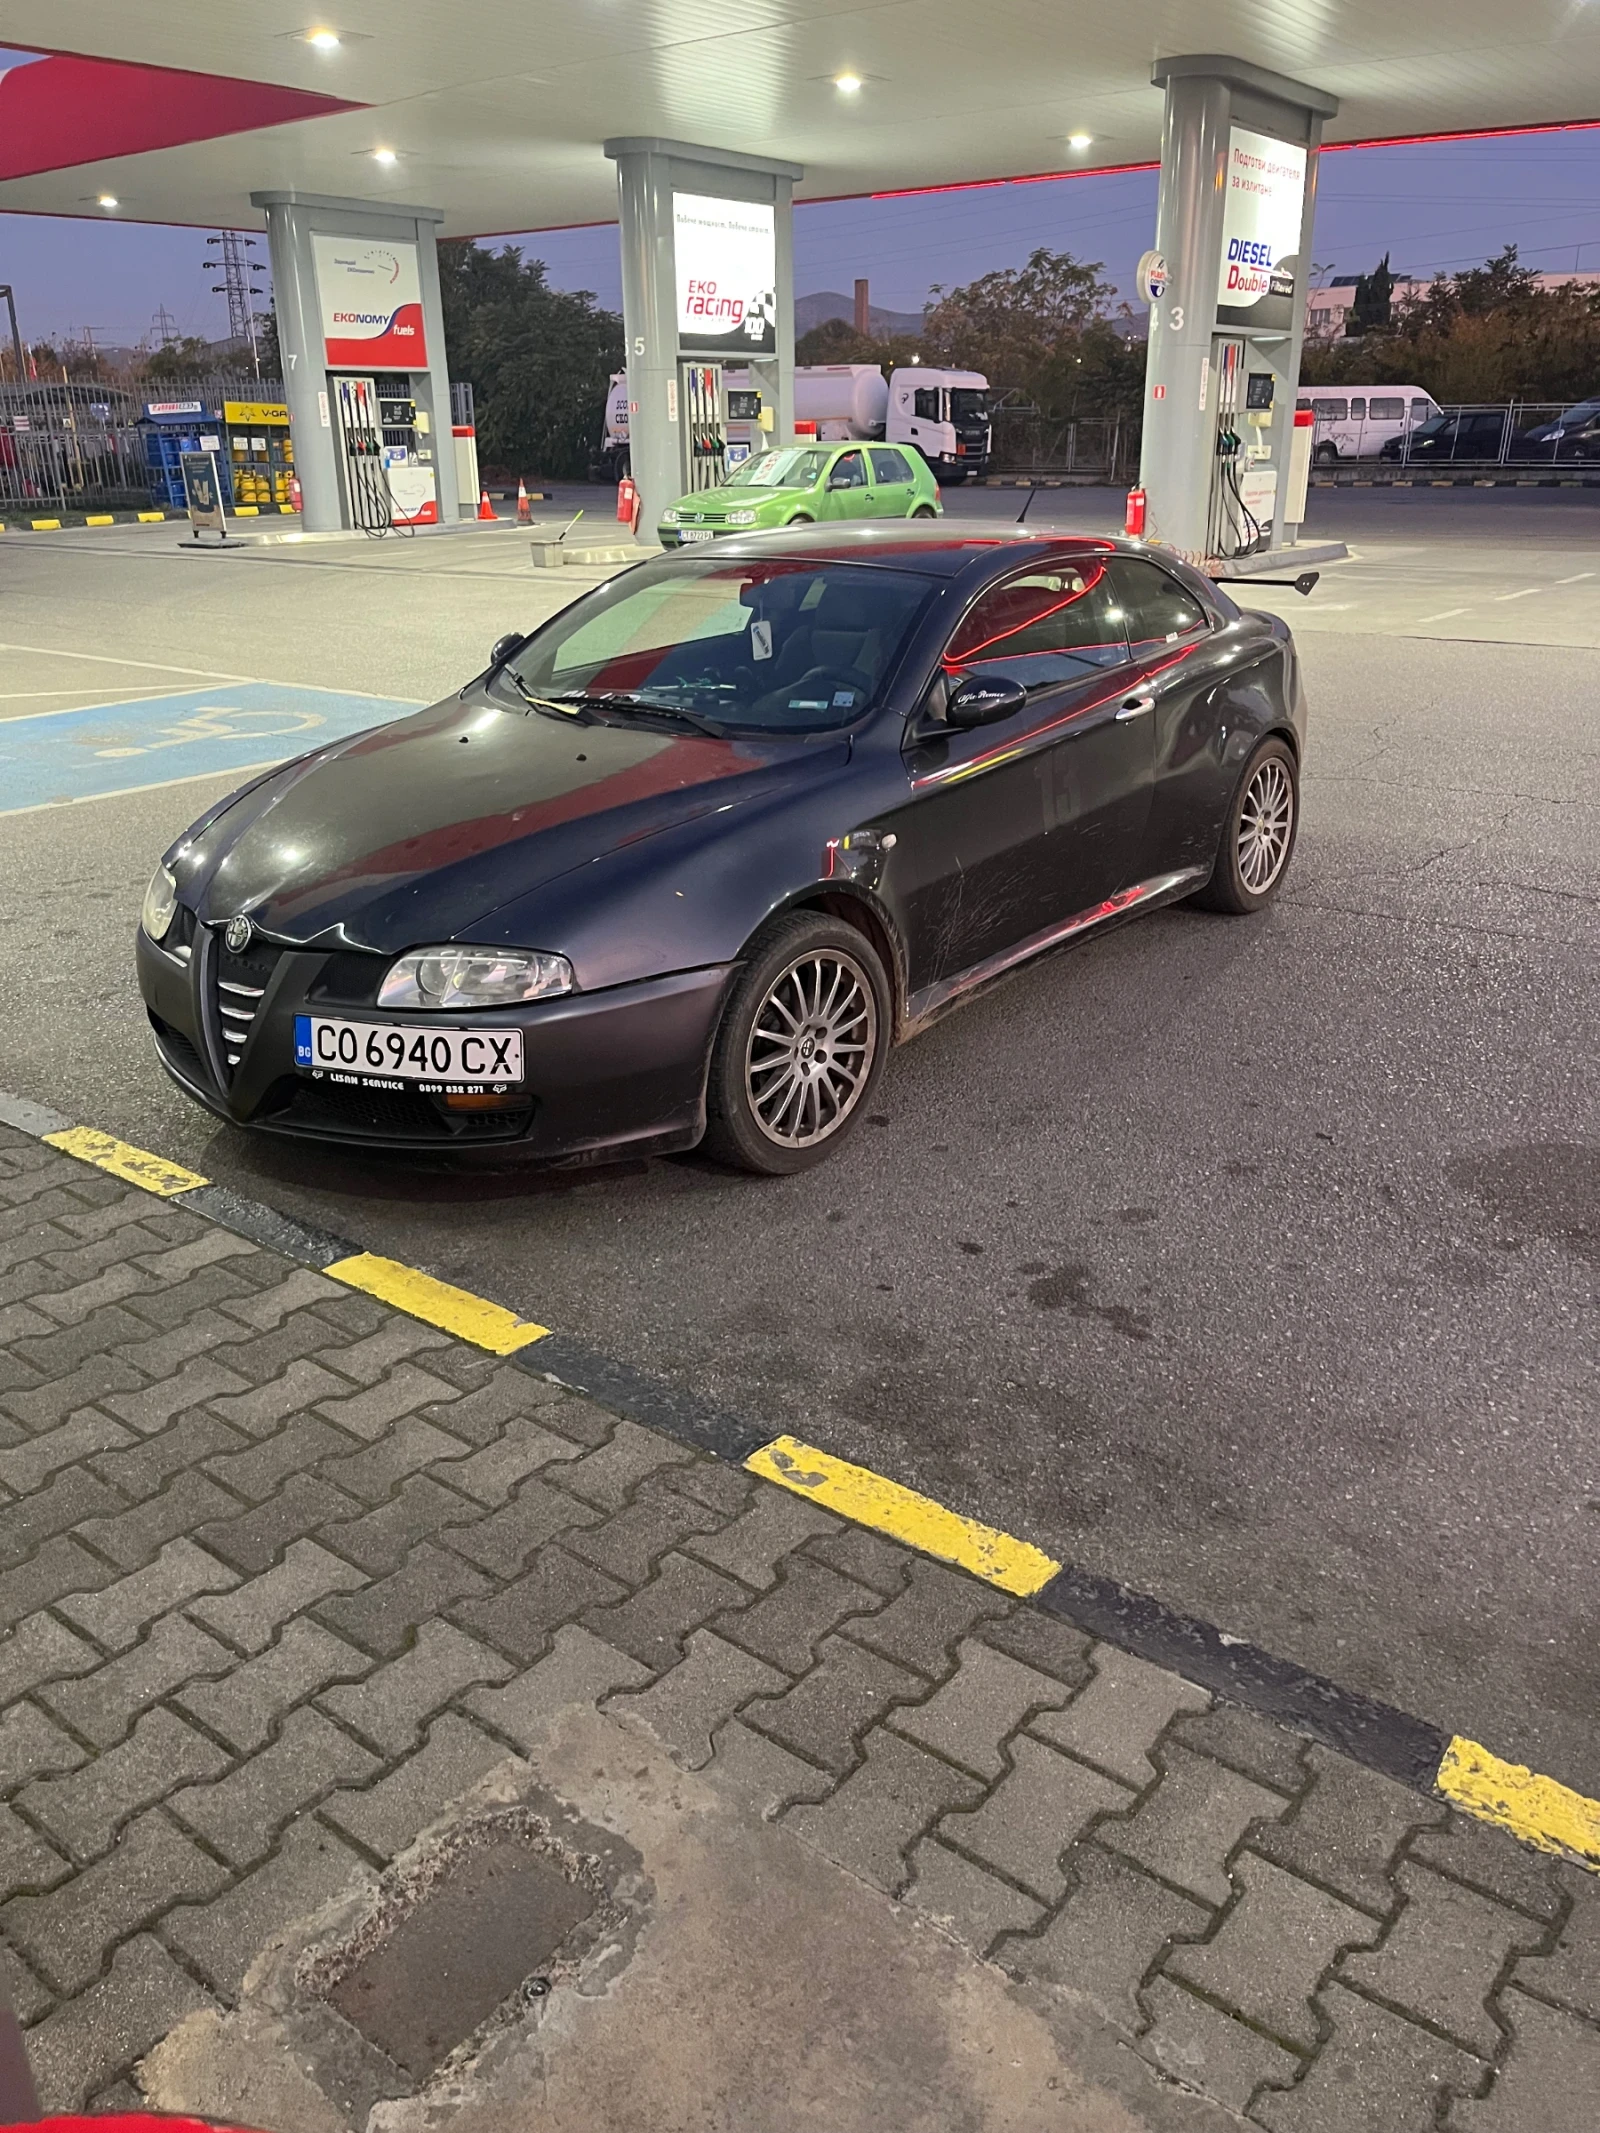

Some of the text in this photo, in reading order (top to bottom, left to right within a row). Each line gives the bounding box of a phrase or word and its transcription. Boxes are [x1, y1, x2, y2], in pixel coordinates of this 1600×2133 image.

[1227, 237, 1272, 267] DIESEL
[688, 279, 717, 295] EKO
[1226, 265, 1268, 293] Double
[333, 312, 390, 325] EKONOMY
[686, 296, 744, 324] racing
[1169, 306, 1185, 331] 3
[393, 324, 415, 336] fuels
[634, 336, 646, 356] 5
[288, 354, 298, 371] 7
[298, 1045, 311, 1058] BG
[317, 1024, 513, 1075] CO 6940 CX
[362, 1078, 405, 1091] SERVICE
[418, 1083, 443, 1093] 0899
[467, 1085, 484, 1094] 271
